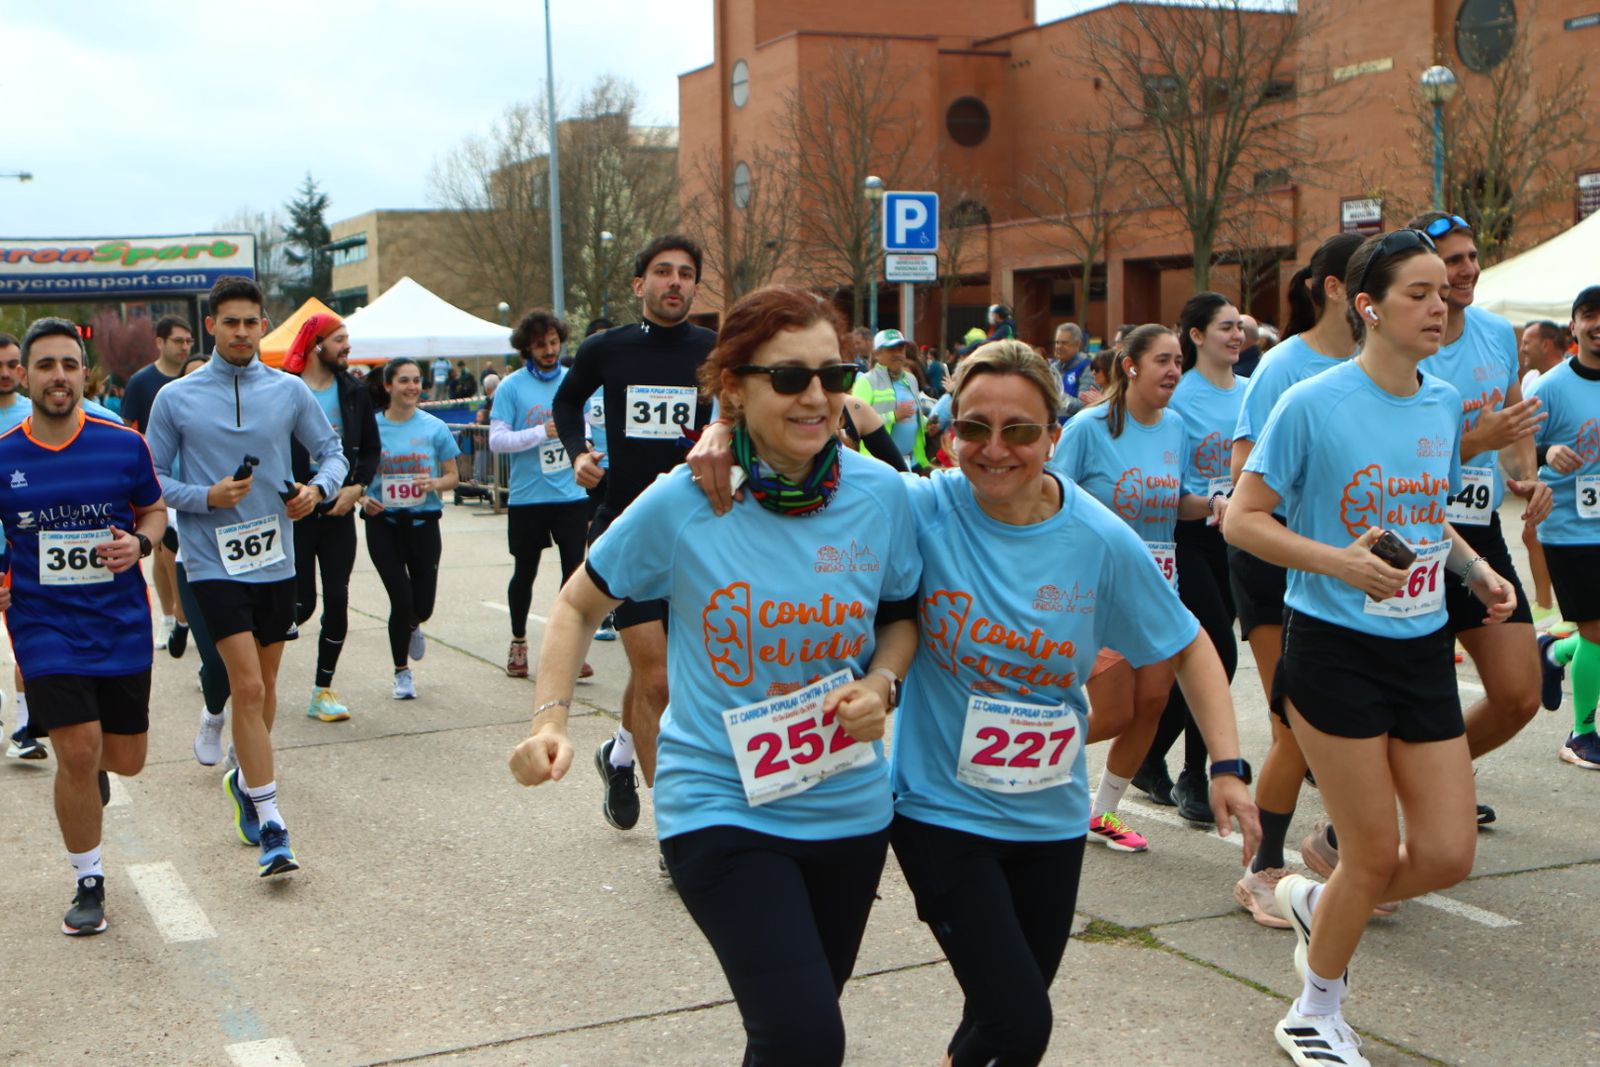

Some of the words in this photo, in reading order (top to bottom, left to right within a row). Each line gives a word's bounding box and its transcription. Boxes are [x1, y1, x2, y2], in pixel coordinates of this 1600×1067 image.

[895, 199, 928, 244] P
[632, 401, 690, 425] 318
[387, 484, 423, 499] 190
[1582, 488, 1600, 506] 3
[225, 529, 277, 561] 367
[758, 638, 795, 667] el
[971, 726, 1075, 769] 227
